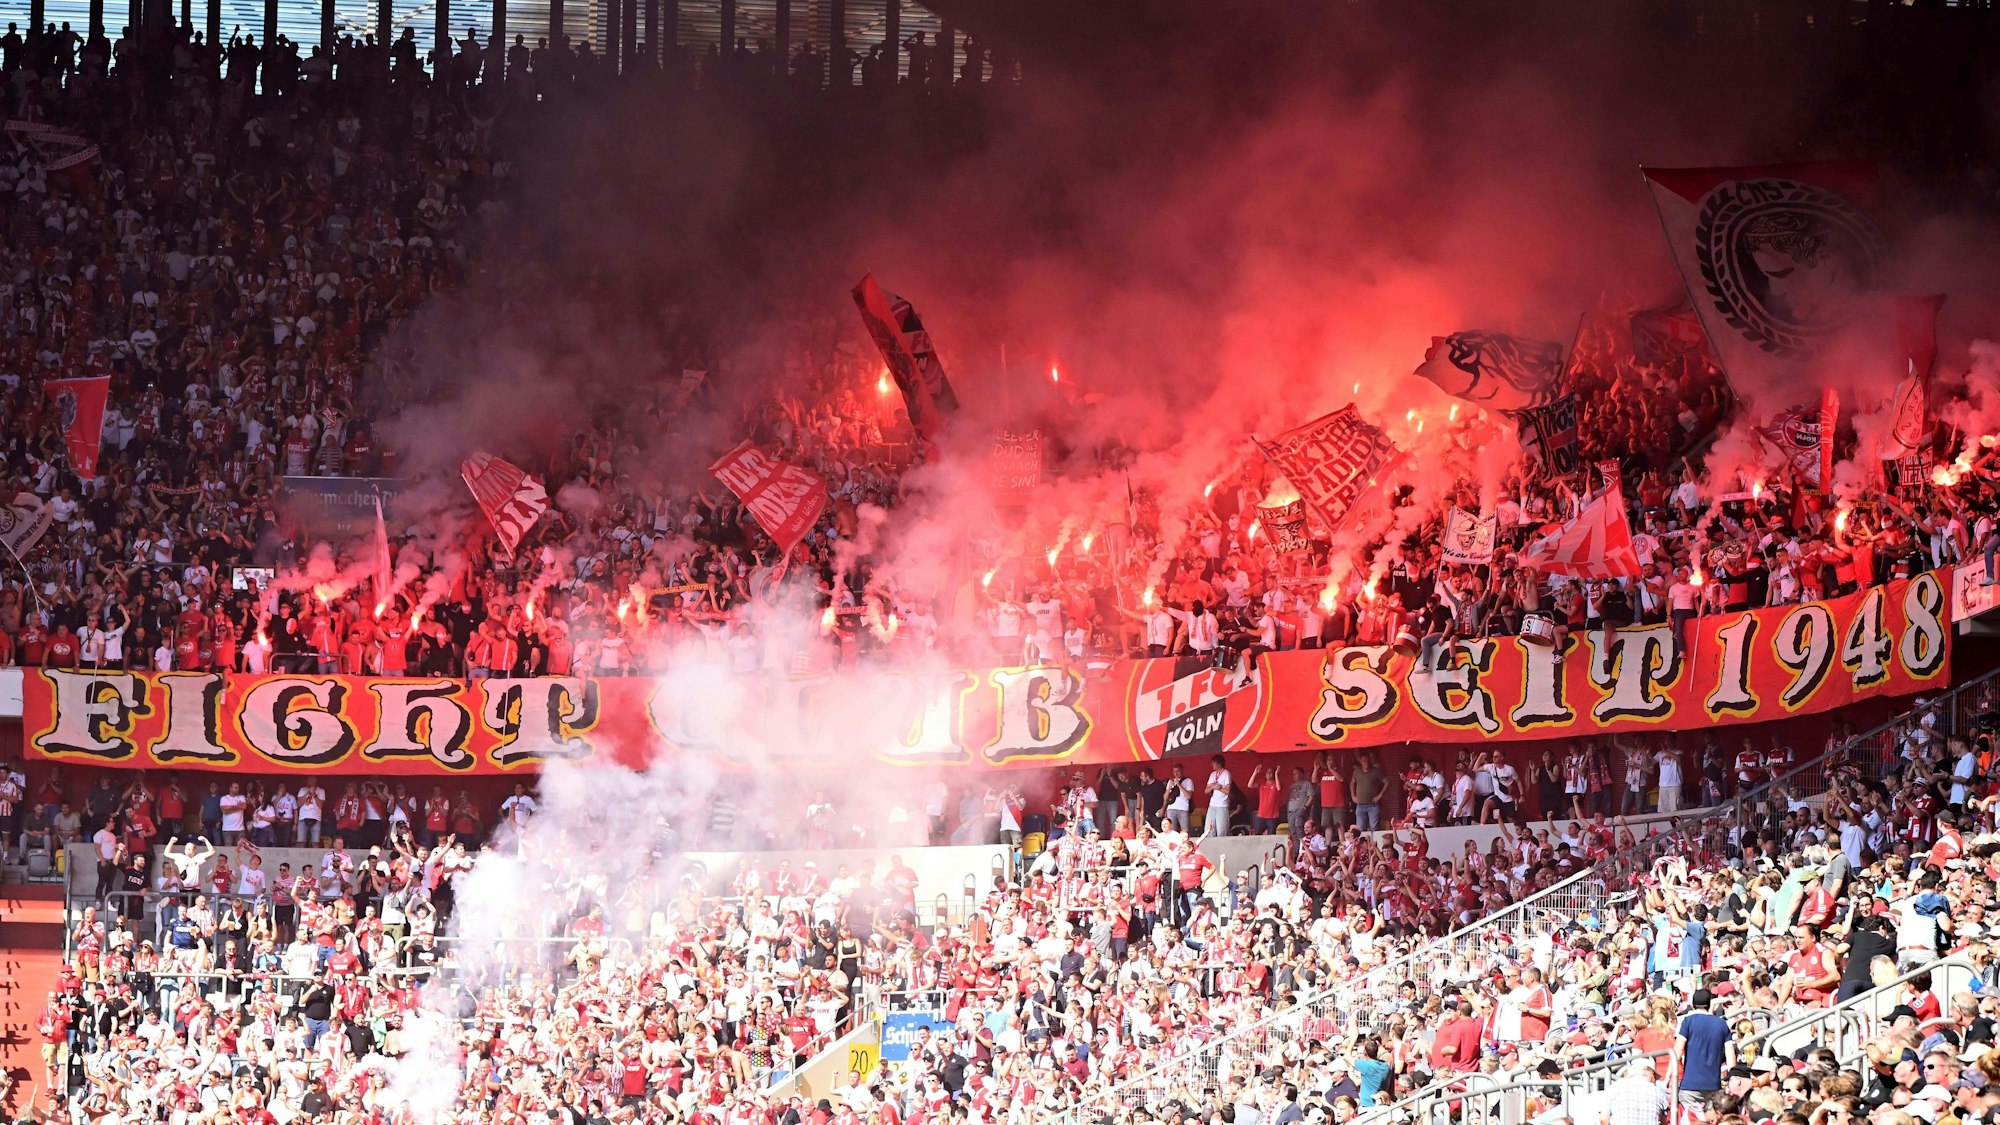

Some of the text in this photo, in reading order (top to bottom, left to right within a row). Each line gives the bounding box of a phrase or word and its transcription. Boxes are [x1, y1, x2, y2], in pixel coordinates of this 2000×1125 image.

[1165, 711, 1223, 752] KÖLN
[1308, 624, 1686, 744] SEIT
[1705, 570, 1947, 724] 1948
